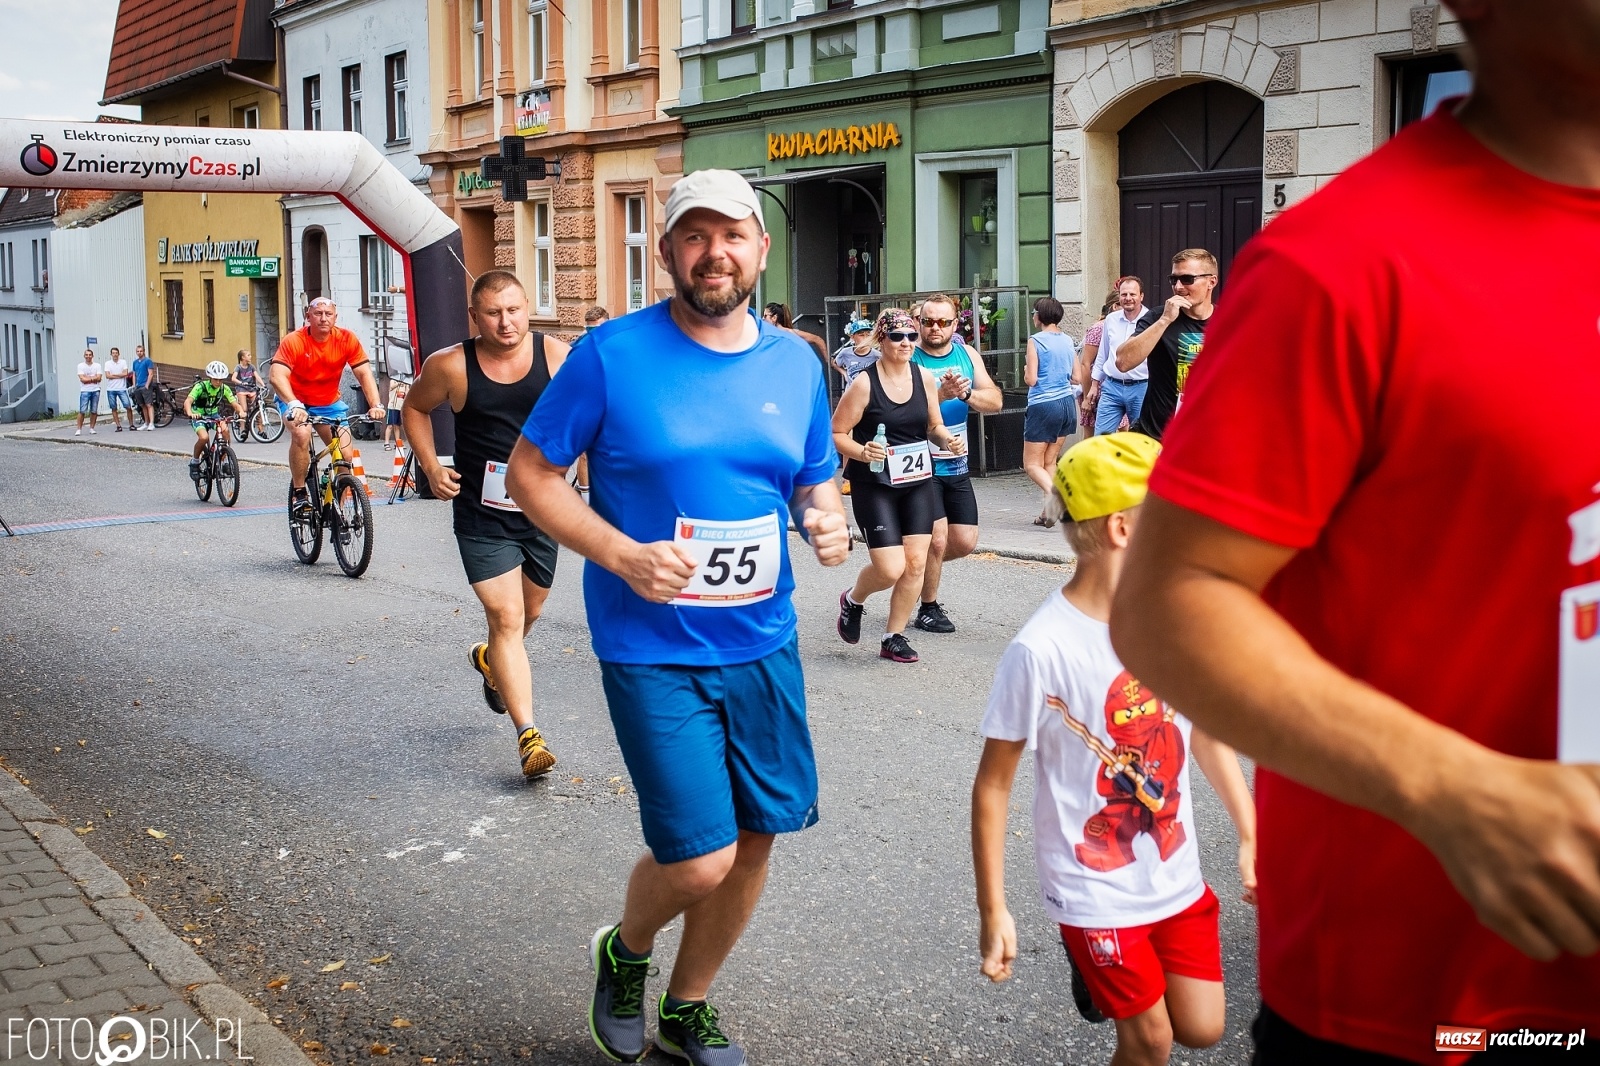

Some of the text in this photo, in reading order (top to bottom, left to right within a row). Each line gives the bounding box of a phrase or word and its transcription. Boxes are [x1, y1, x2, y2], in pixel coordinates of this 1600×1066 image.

[63, 129, 251, 146] Elektroniczny pomiar czasu
[767, 121, 900, 161] KWIACIARNIA
[62, 152, 261, 180] ZmierzymyCzas.pl
[1273, 183, 1287, 207] 5
[172, 243, 193, 263] BANK
[228, 258, 260, 266] BANKOMAT
[902, 452, 924, 474] 24
[701, 529, 724, 540] BIEG
[703, 544, 761, 587] 55
